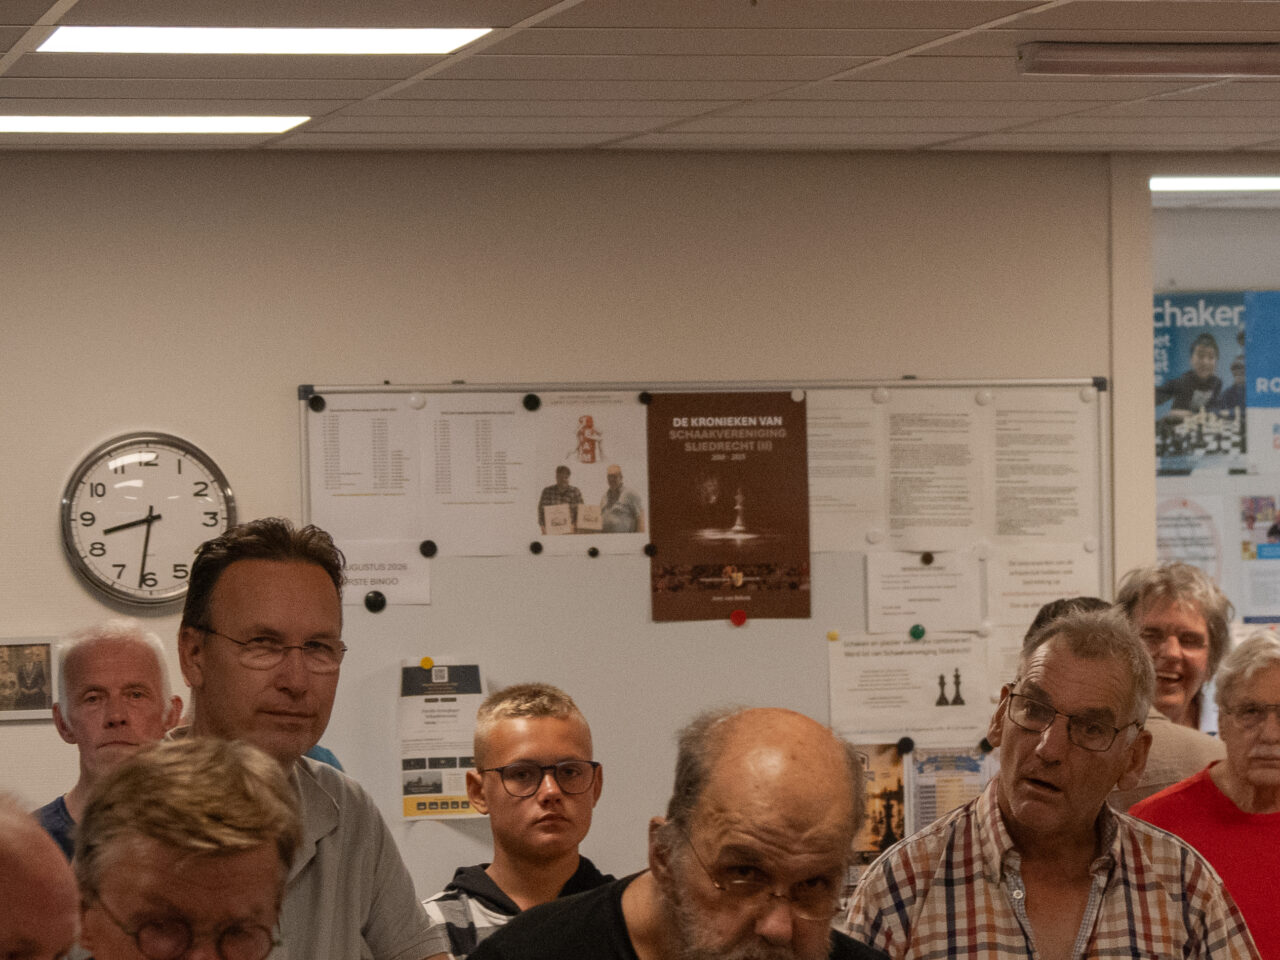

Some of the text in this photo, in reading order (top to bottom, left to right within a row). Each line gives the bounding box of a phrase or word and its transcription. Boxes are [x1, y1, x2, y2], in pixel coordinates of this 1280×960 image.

[673, 416, 783, 427] DE KRONIEKEN VAN
[669, 428, 787, 440] SCHAAKVERENIGING
[684, 441, 755, 451] SLIEDRECHT
[90, 482, 106, 498] 10
[193, 482, 209, 497] 2
[80, 511, 96, 527] 9
[202, 511, 219, 528] 3
[89, 542, 106, 557] 8
[112, 564, 126, 579] 7
[172, 564, 189, 579] 5
[343, 563, 386, 571] UGUSTUS
[142, 572, 158, 587] 6
[370, 577, 399, 586] BINGO
